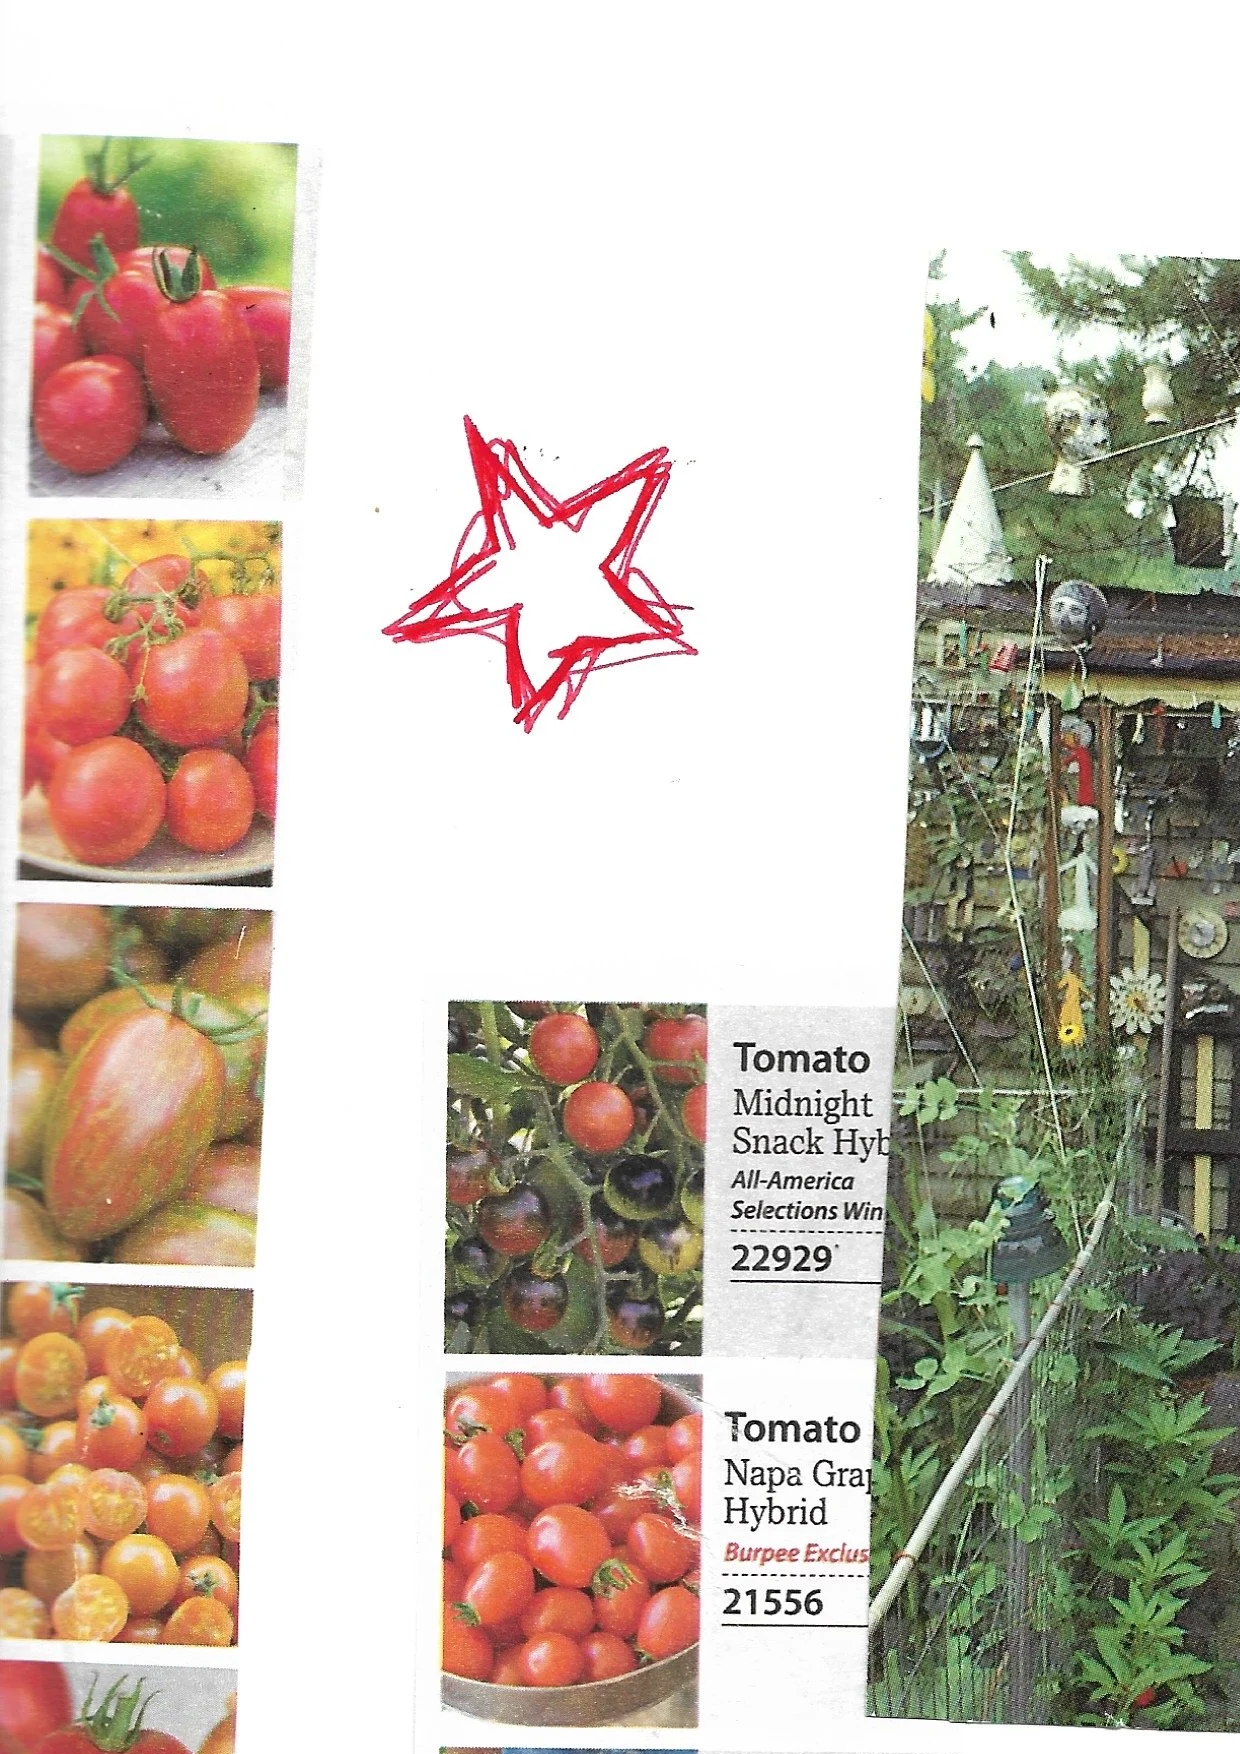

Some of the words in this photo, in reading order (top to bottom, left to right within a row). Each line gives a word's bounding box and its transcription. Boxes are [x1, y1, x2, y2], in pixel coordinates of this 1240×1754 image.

[733, 1042, 871, 1073] Tomato
[733, 1088, 873, 1124] Midnight
[733, 1127, 824, 1154] Snack
[833, 1128, 890, 1163] Hyb
[731, 1170, 854, 1190] All-America
[730, 1200, 838, 1220] Selections
[843, 1202, 883, 1220] Win
[731, 1244, 832, 1272] 22929
[724, 1411, 861, 1443] Tomato
[724, 1459, 803, 1493] Napa
[724, 1497, 828, 1532] Hybrid
[724, 1542, 800, 1566] Burpee
[803, 1542, 869, 1563] Exclus
[723, 1588, 823, 1616] 21556
